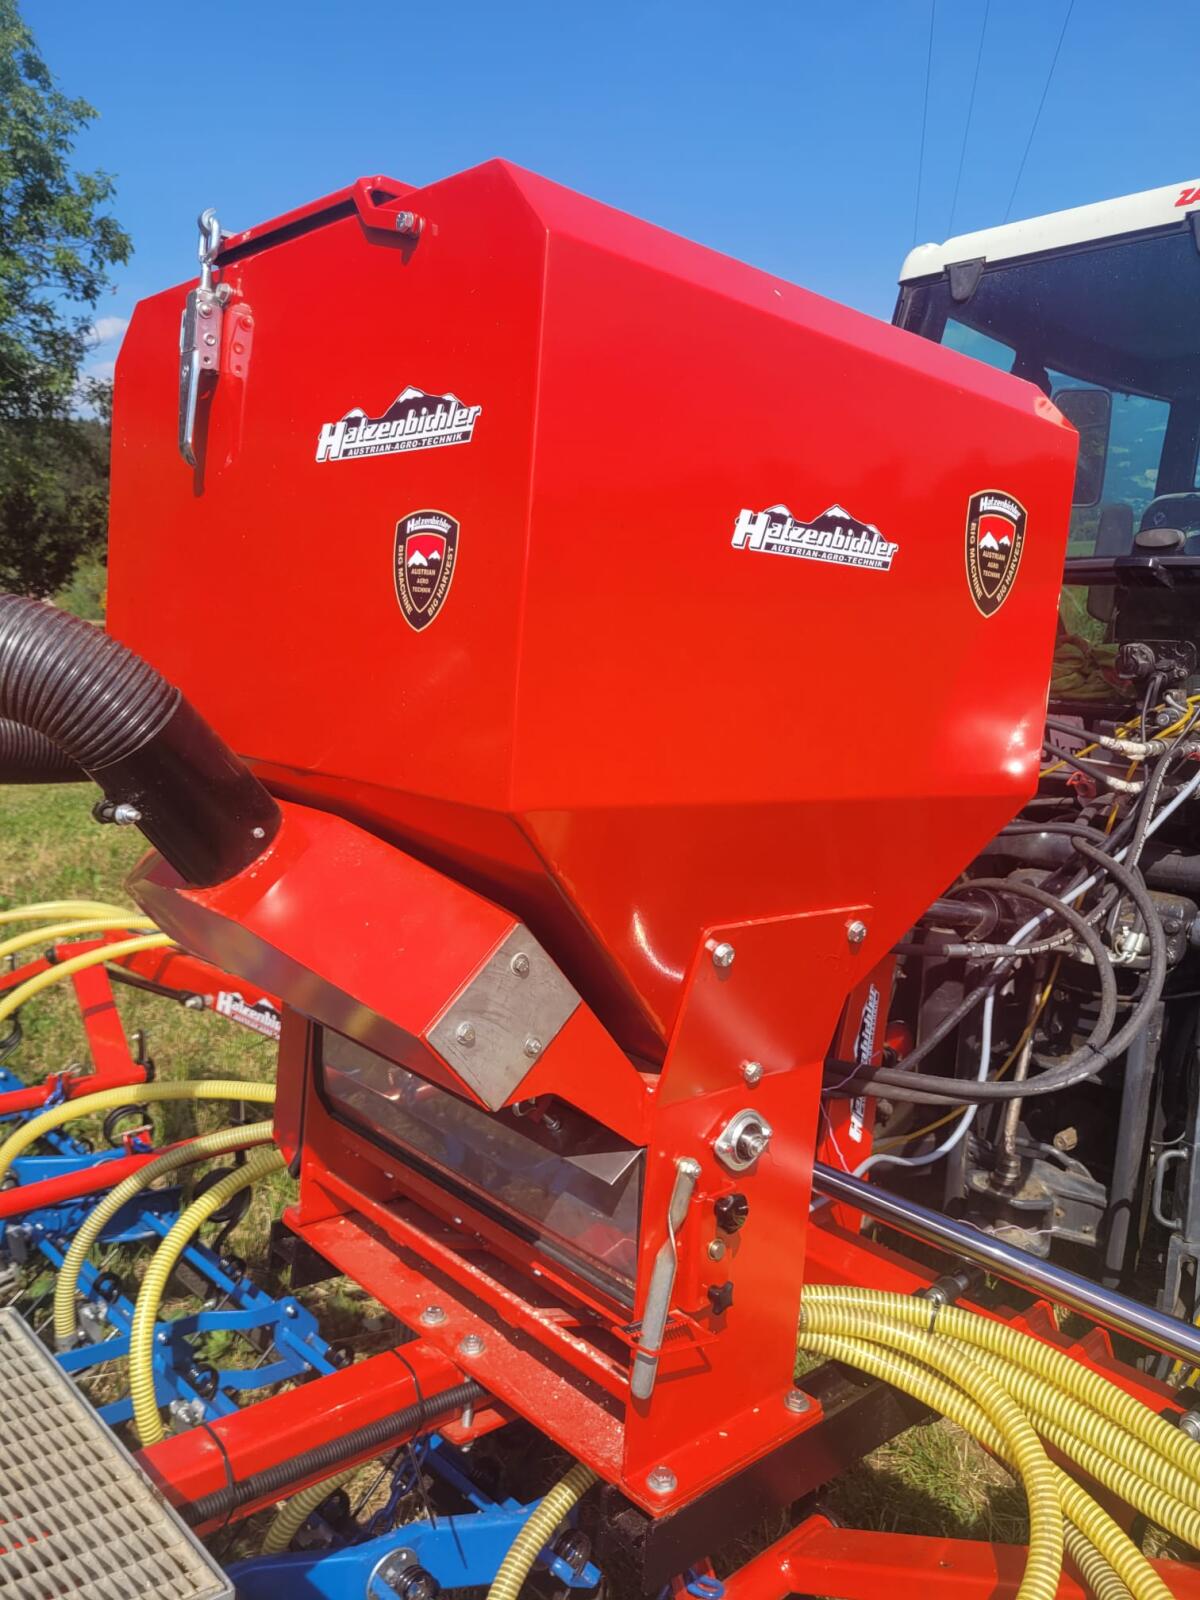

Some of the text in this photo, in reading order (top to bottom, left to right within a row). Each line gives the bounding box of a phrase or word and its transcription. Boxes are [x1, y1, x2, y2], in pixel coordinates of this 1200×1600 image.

[317, 401, 481, 461] Hatzenbichler
[347, 432, 463, 457] AUSTRIAN-AGRO-TECHNIK
[731, 509, 898, 558] Hatzenbichler
[771, 544, 883, 568] AUSTRIAN-AGRO-TECHNIK
[982, 550, 1006, 561] AUSTRIAN
[411, 568, 436, 577] AUSTRIAN
[427, 545, 454, 617] BIG HARVEST
[969, 522, 983, 600] BIG MACHINE
[996, 533, 1022, 602] BIG HARVEST
[398, 567, 413, 616] MACHINE
